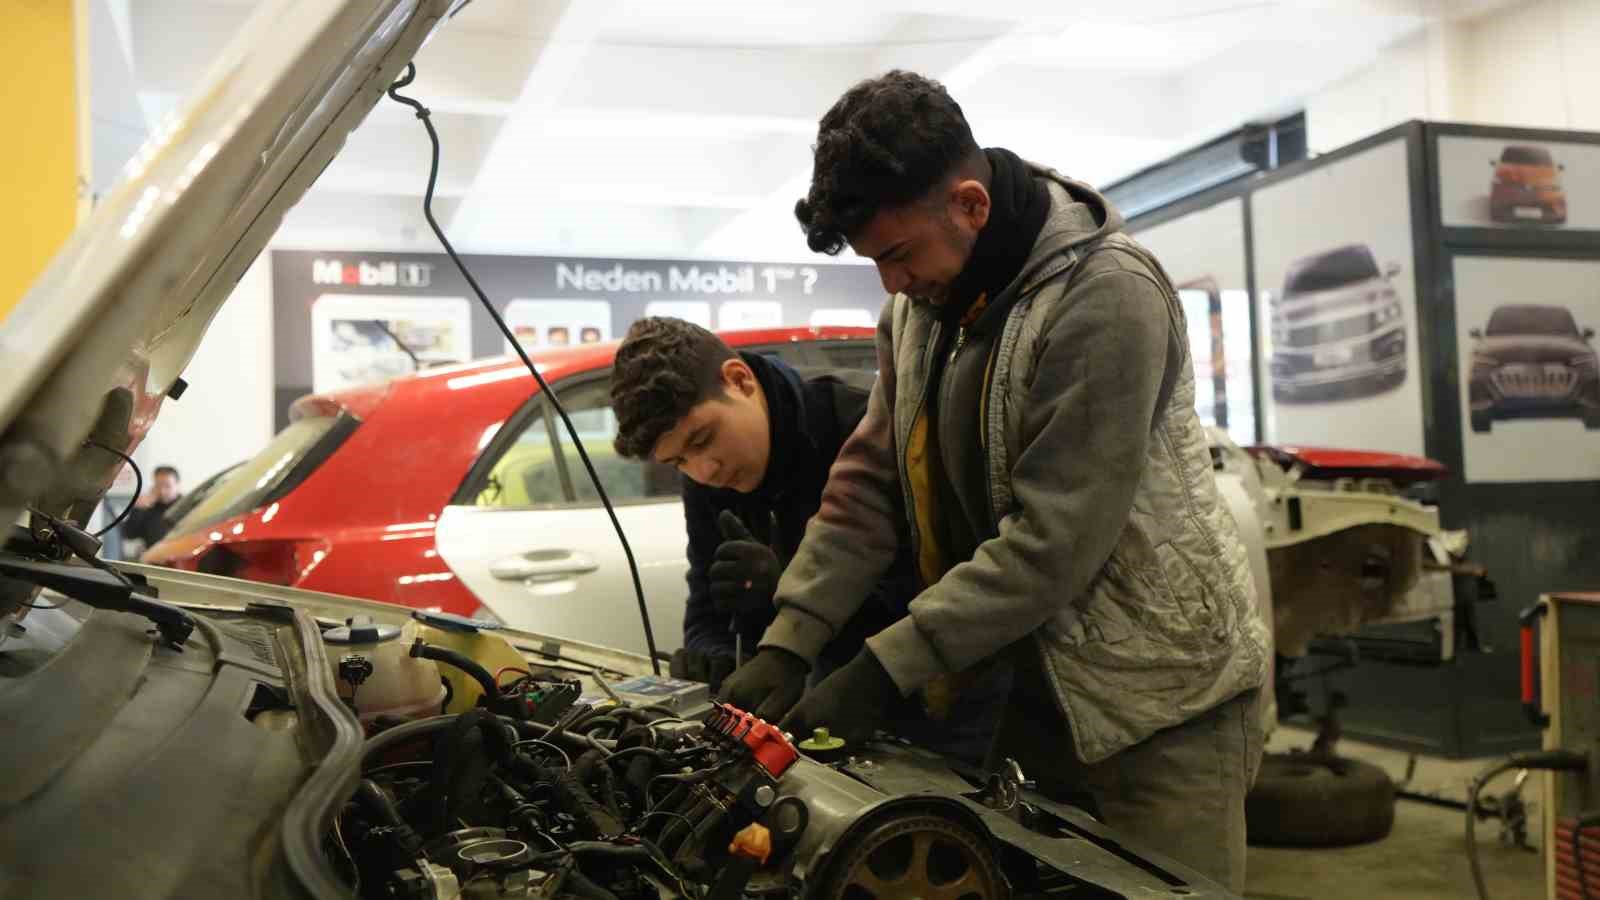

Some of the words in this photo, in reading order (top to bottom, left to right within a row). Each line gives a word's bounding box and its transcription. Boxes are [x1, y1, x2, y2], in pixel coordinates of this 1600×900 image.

[312, 259, 397, 286] Mobil
[555, 263, 662, 292] Neden
[668, 265, 754, 294] Mobil
